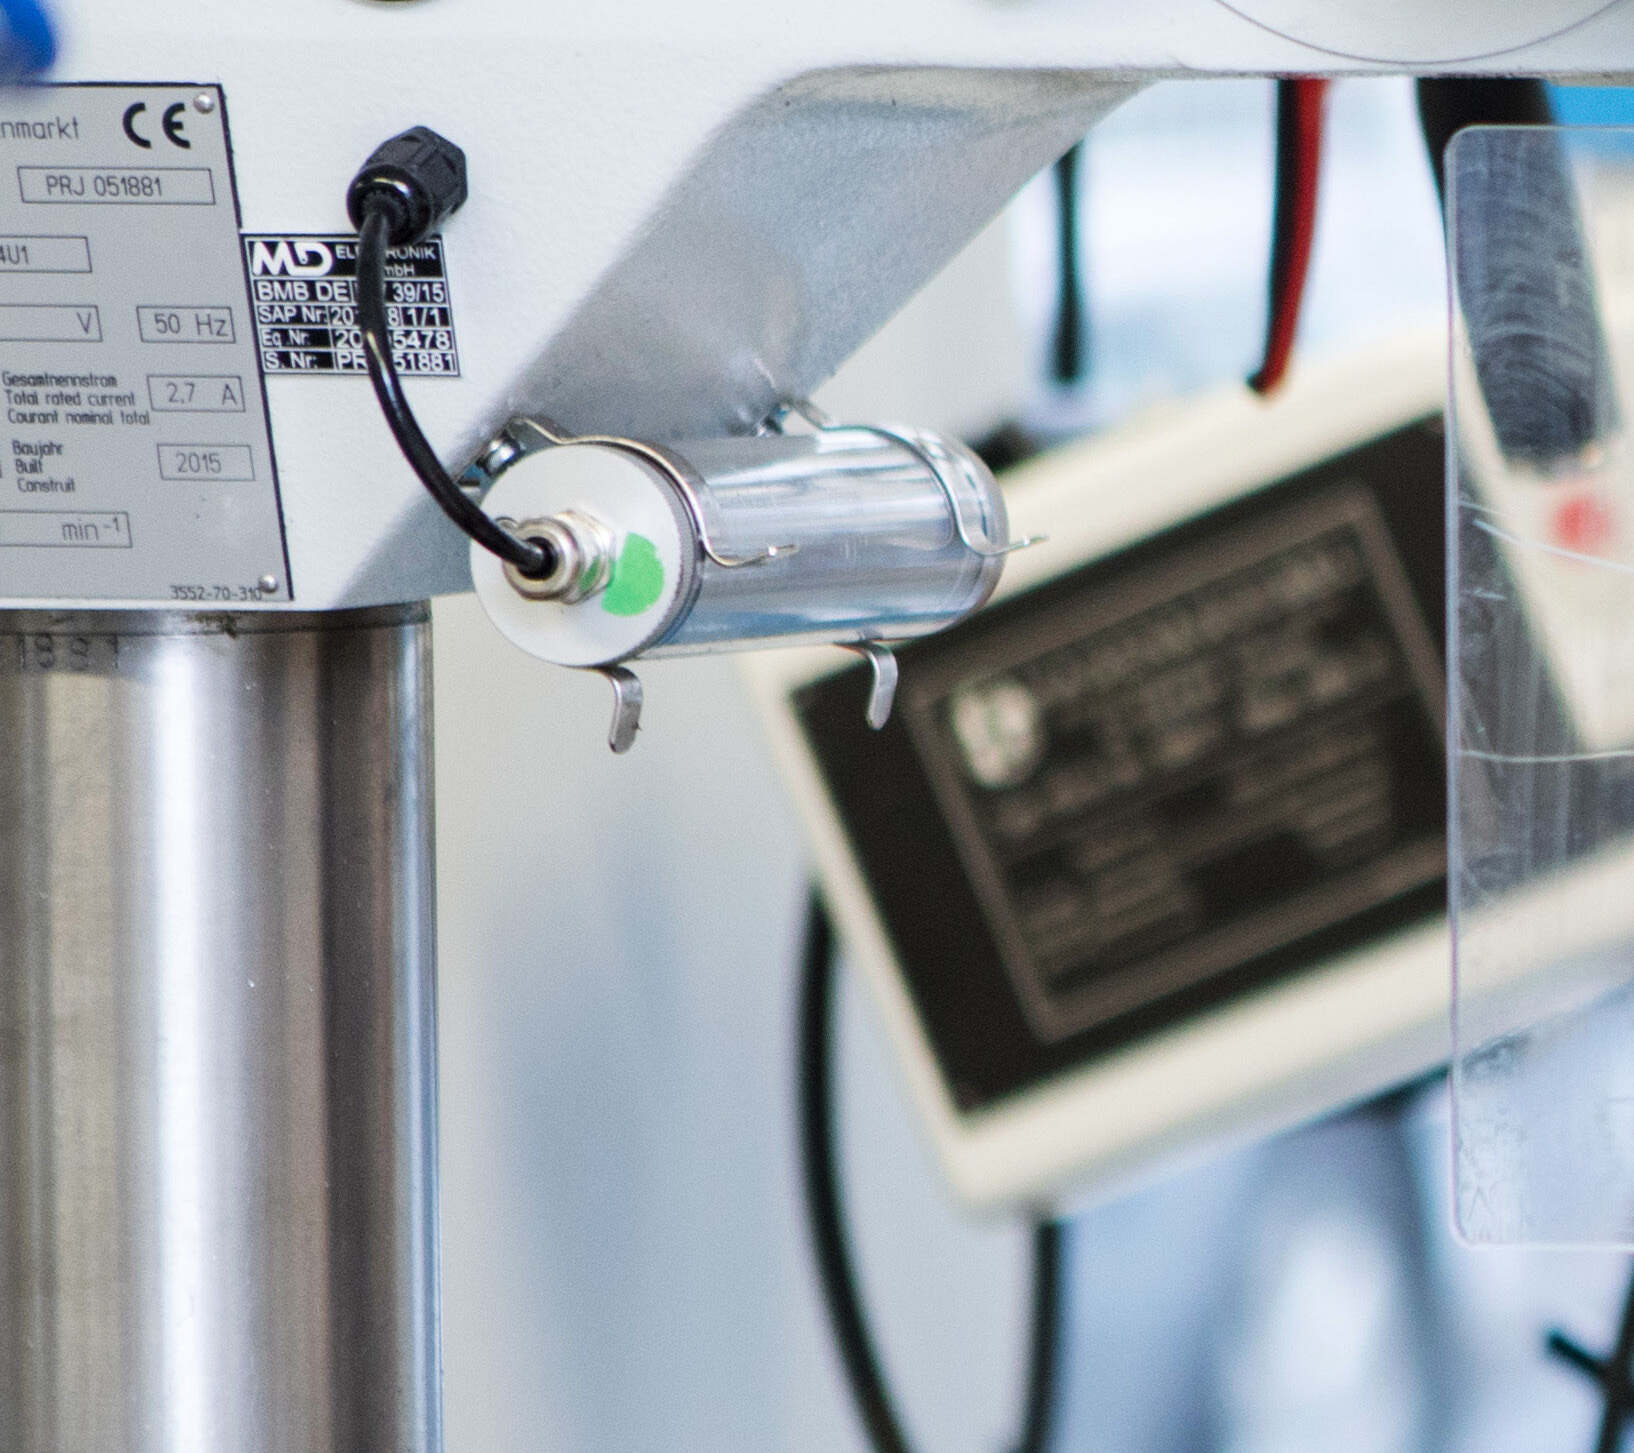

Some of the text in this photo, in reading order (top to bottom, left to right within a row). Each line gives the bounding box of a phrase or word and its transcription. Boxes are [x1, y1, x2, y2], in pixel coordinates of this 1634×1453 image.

[46, 175, 162, 197] PRJ 051881
[253, 241, 333, 277] MD
[384, 263, 415, 277] mbH
[256, 281, 309, 302] BMB
[315, 281, 349, 302] DE
[393, 282, 444, 303] 39/15
[76, 312, 92, 334] V
[154, 313, 229, 337] 50 Hz
[258, 306, 296, 323] SAP
[407, 308, 440, 326] 1/1
[290, 351, 318, 369] Nr.
[1, 370, 118, 388] Gesamtnennstrom
[5, 389, 135, 407] Total rated current
[222, 384, 238, 405] A
[7, 408, 150, 426] Courant nominal total
[12, 439, 64, 459] Baujahr
[15, 458, 43, 474] Built
[175, 451, 222, 474] 2015
[17, 477, 76, 493] Construit
[170, 586, 262, 601] 3552-70-310
